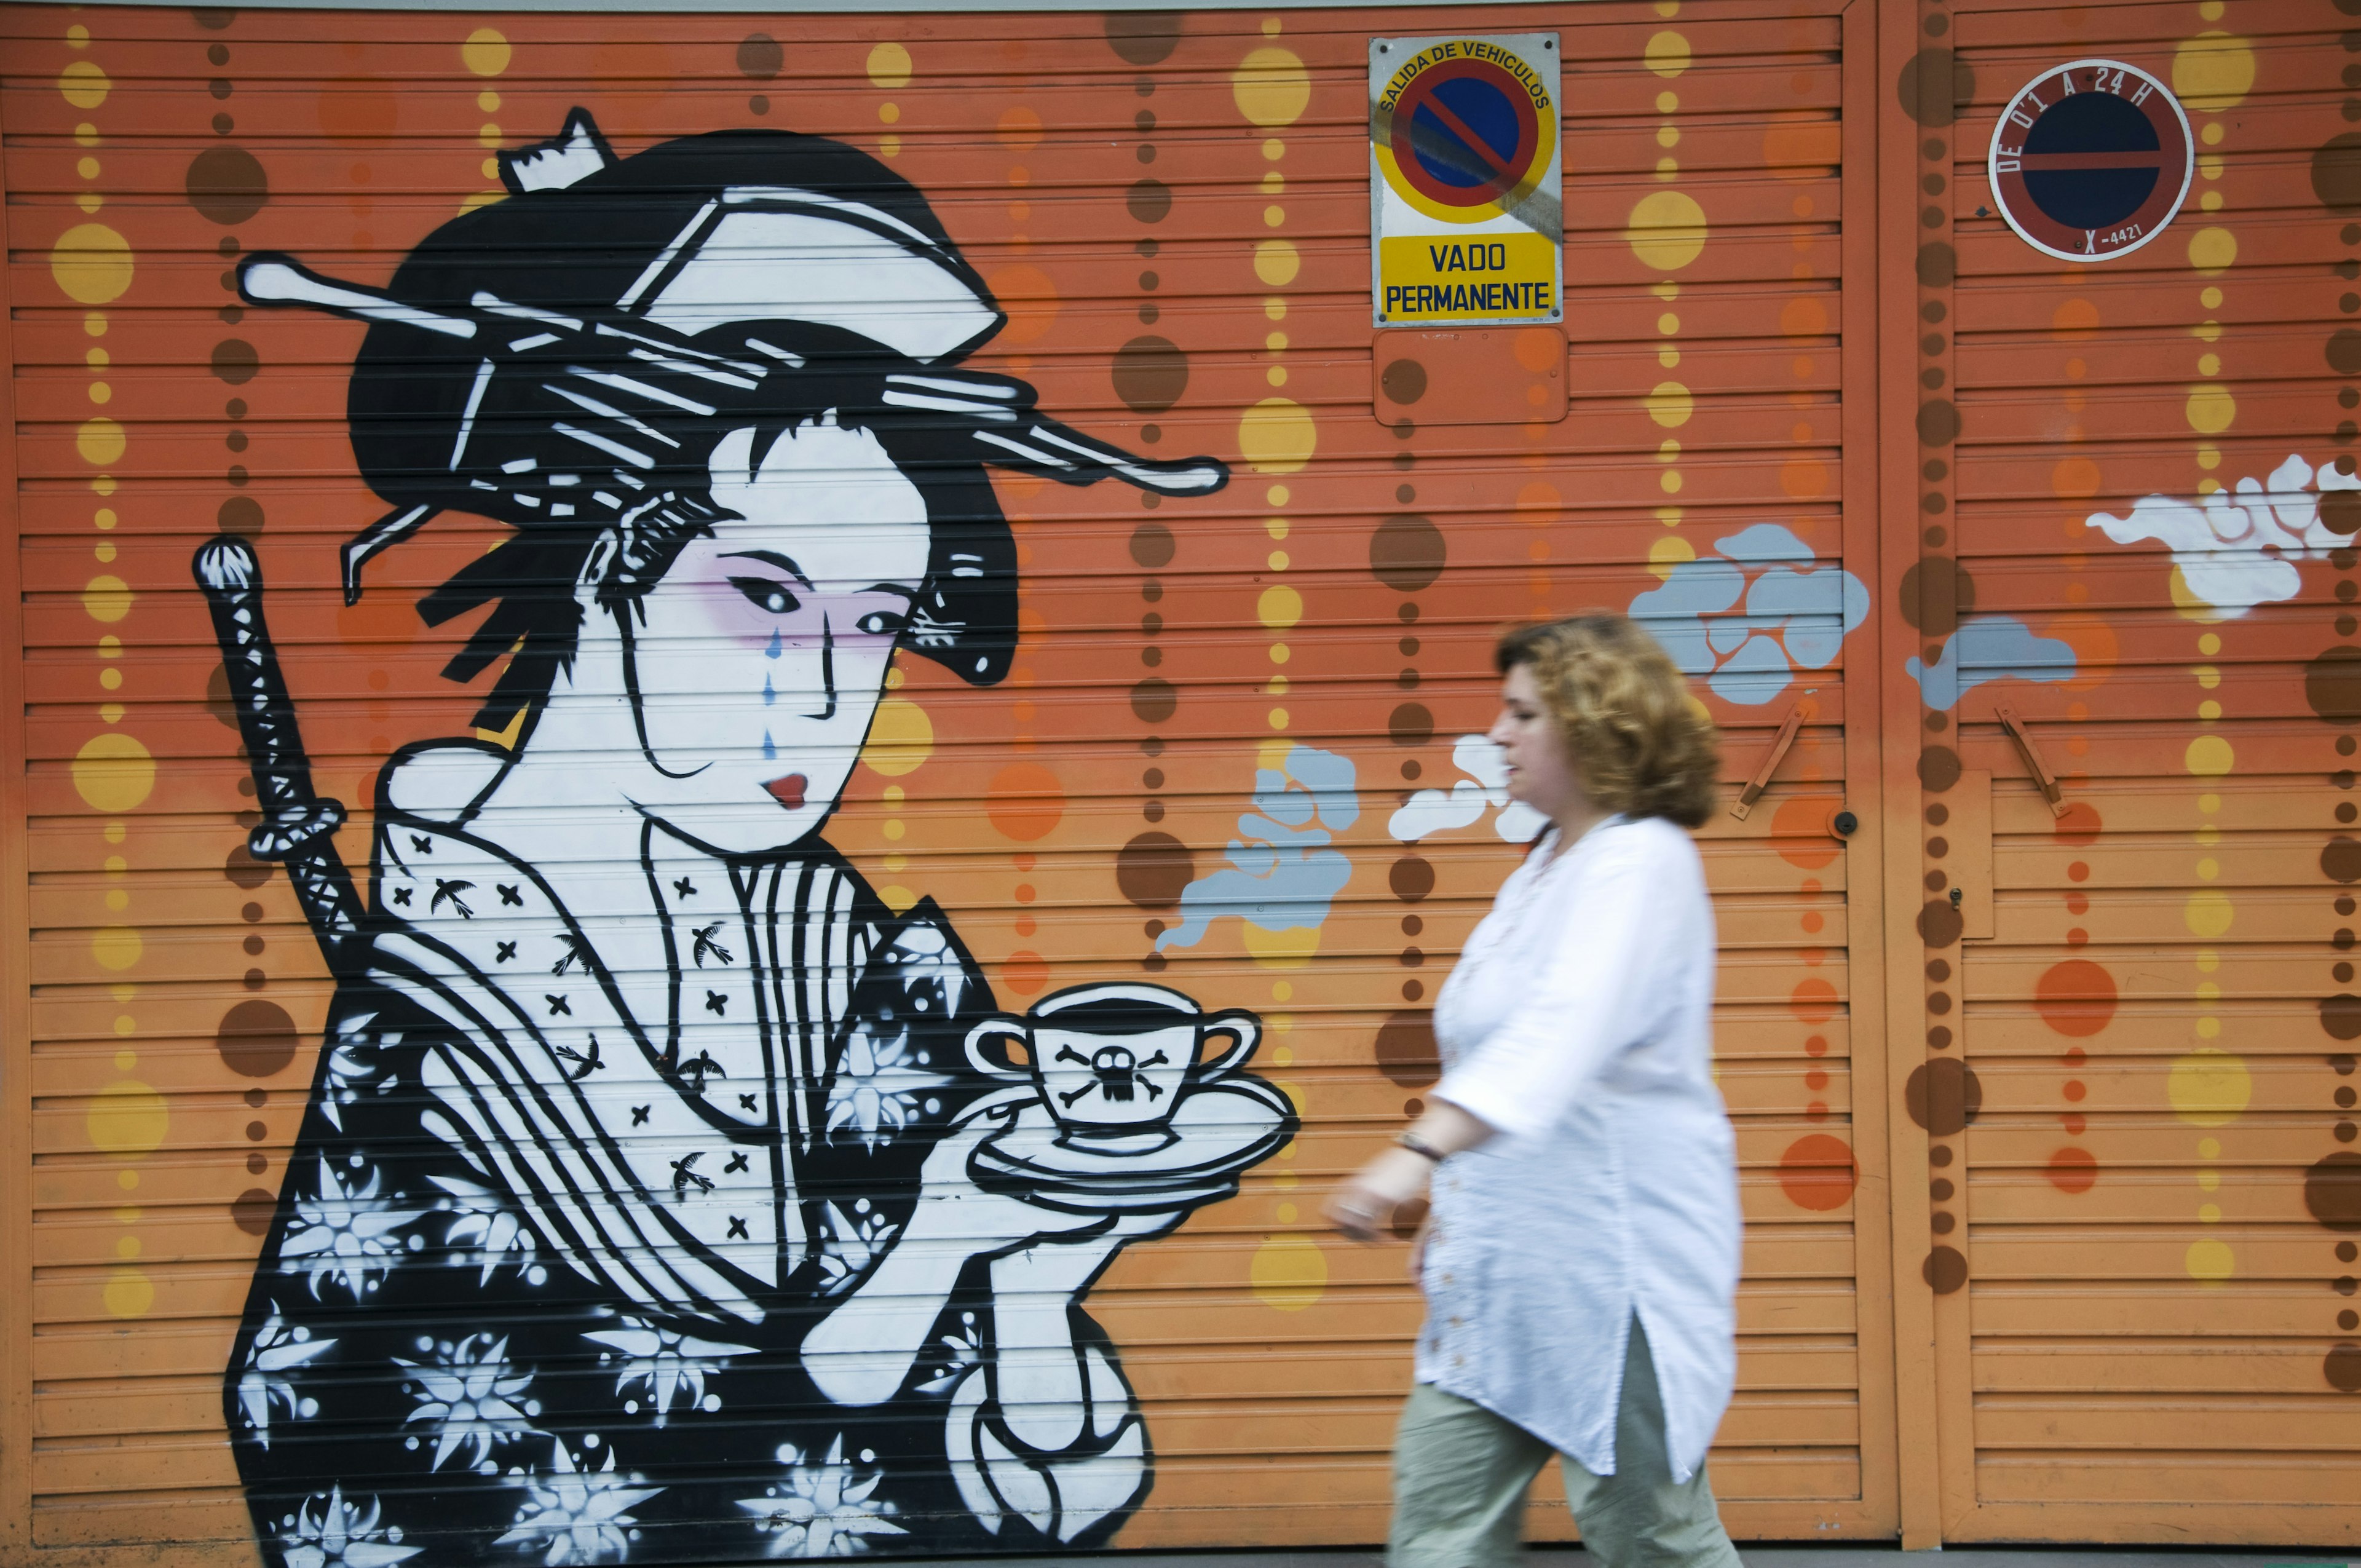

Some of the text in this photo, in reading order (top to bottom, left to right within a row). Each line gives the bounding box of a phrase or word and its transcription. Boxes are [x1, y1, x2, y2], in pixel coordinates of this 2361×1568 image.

[1380, 42, 1549, 113] SALIDA DE VEHICULOS
[1996, 144, 2022, 173] DE
[2063, 72, 2076, 96] A
[2094, 67, 2125, 95] 24
[2130, 82, 2153, 106] H
[1430, 244, 1505, 272] VADO
[1386, 282, 1549, 312] PERMANENTE
